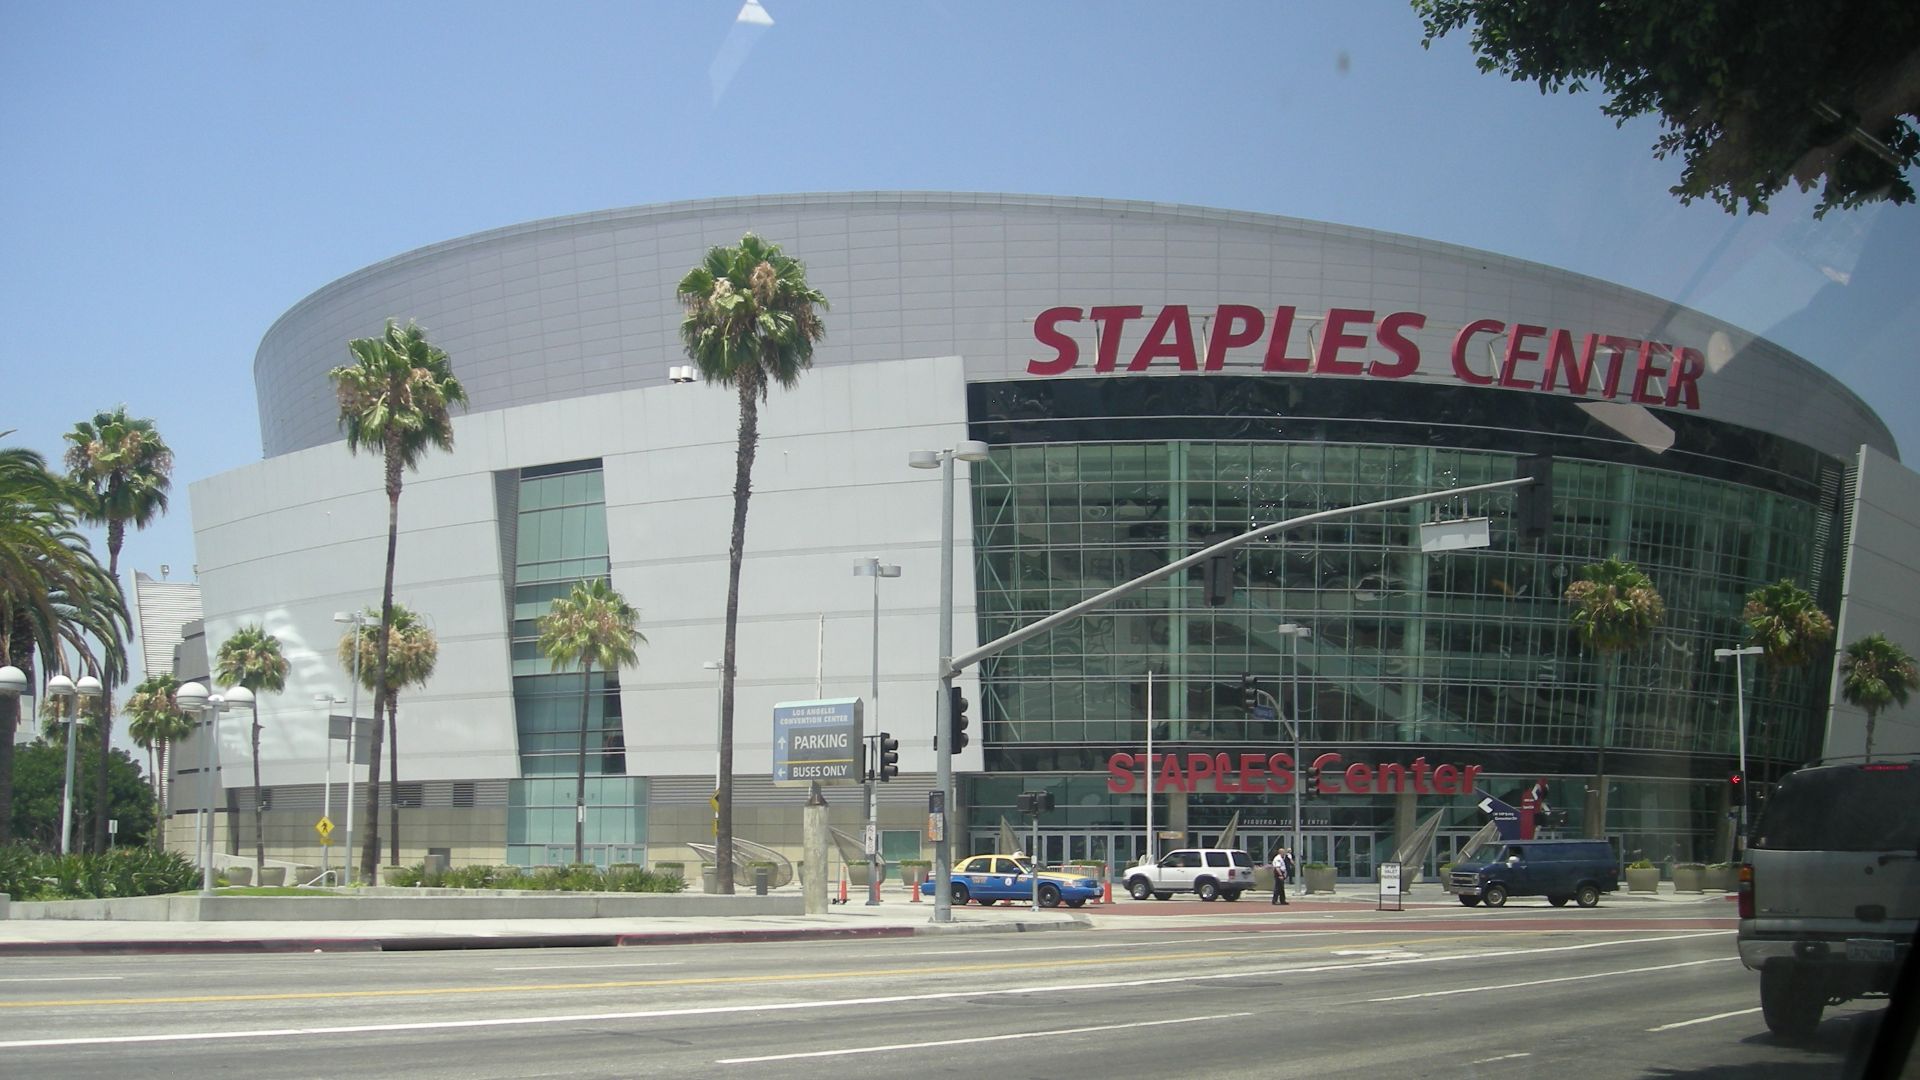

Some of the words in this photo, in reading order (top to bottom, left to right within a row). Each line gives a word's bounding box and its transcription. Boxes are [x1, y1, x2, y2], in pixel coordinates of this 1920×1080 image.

[1026, 304, 1427, 379] STAPLES
[1452, 319, 1706, 411] CENTER
[806, 706, 835, 715] ANGELES
[780, 716, 822, 725] CONVENTION
[824, 714, 849, 723] CENTER
[794, 733, 848, 750] PARKING
[793, 766, 821, 777] BUSES
[823, 765, 848, 776] ONLY
[1106, 752, 1296, 794] STAPLES
[1311, 753, 1483, 795] Center
